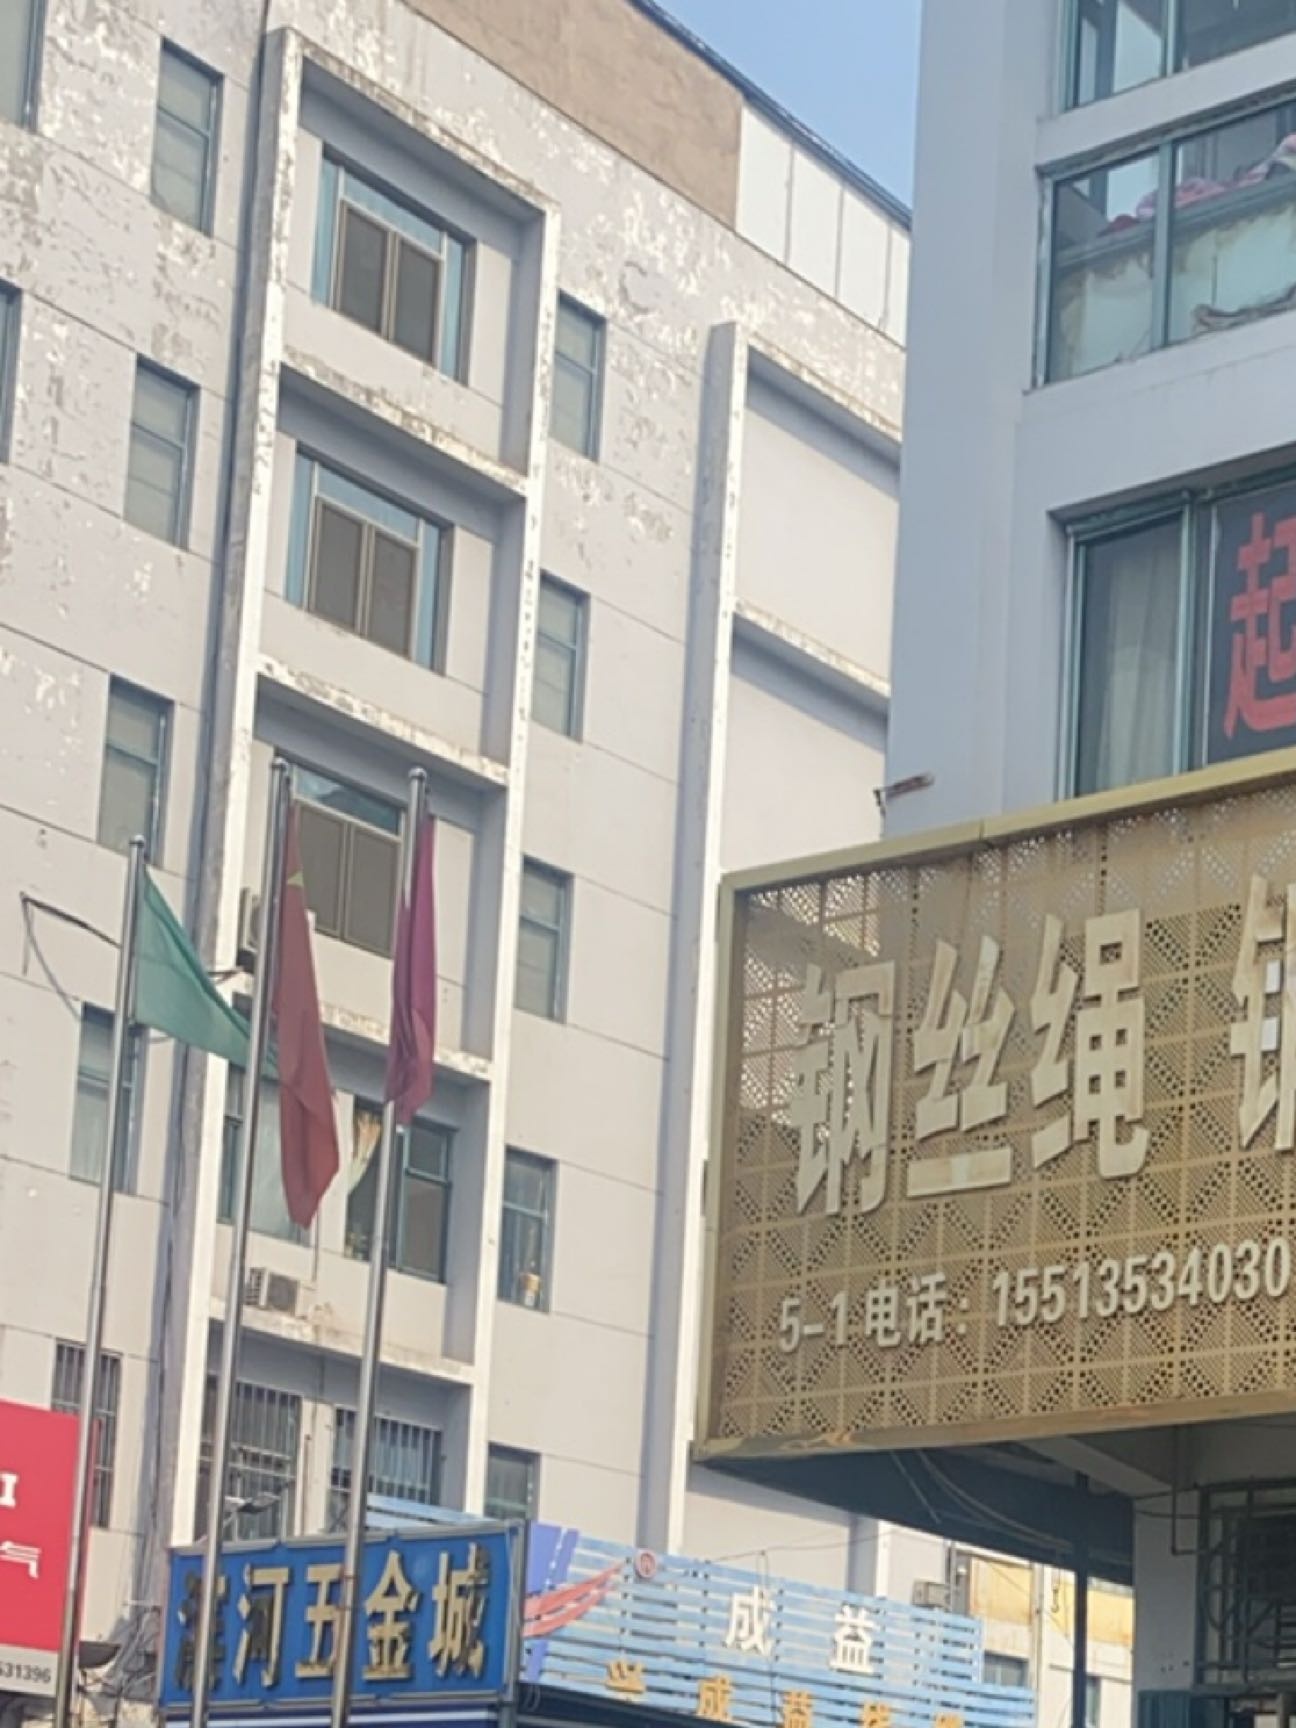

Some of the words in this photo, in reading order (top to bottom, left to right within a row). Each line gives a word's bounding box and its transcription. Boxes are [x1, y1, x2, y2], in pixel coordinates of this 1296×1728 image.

[793, 906, 1151, 1222] 钢丝绳
[990, 1236, 1292, 1330] 15513534030
[0, 1660, 51, 1684] 31396
